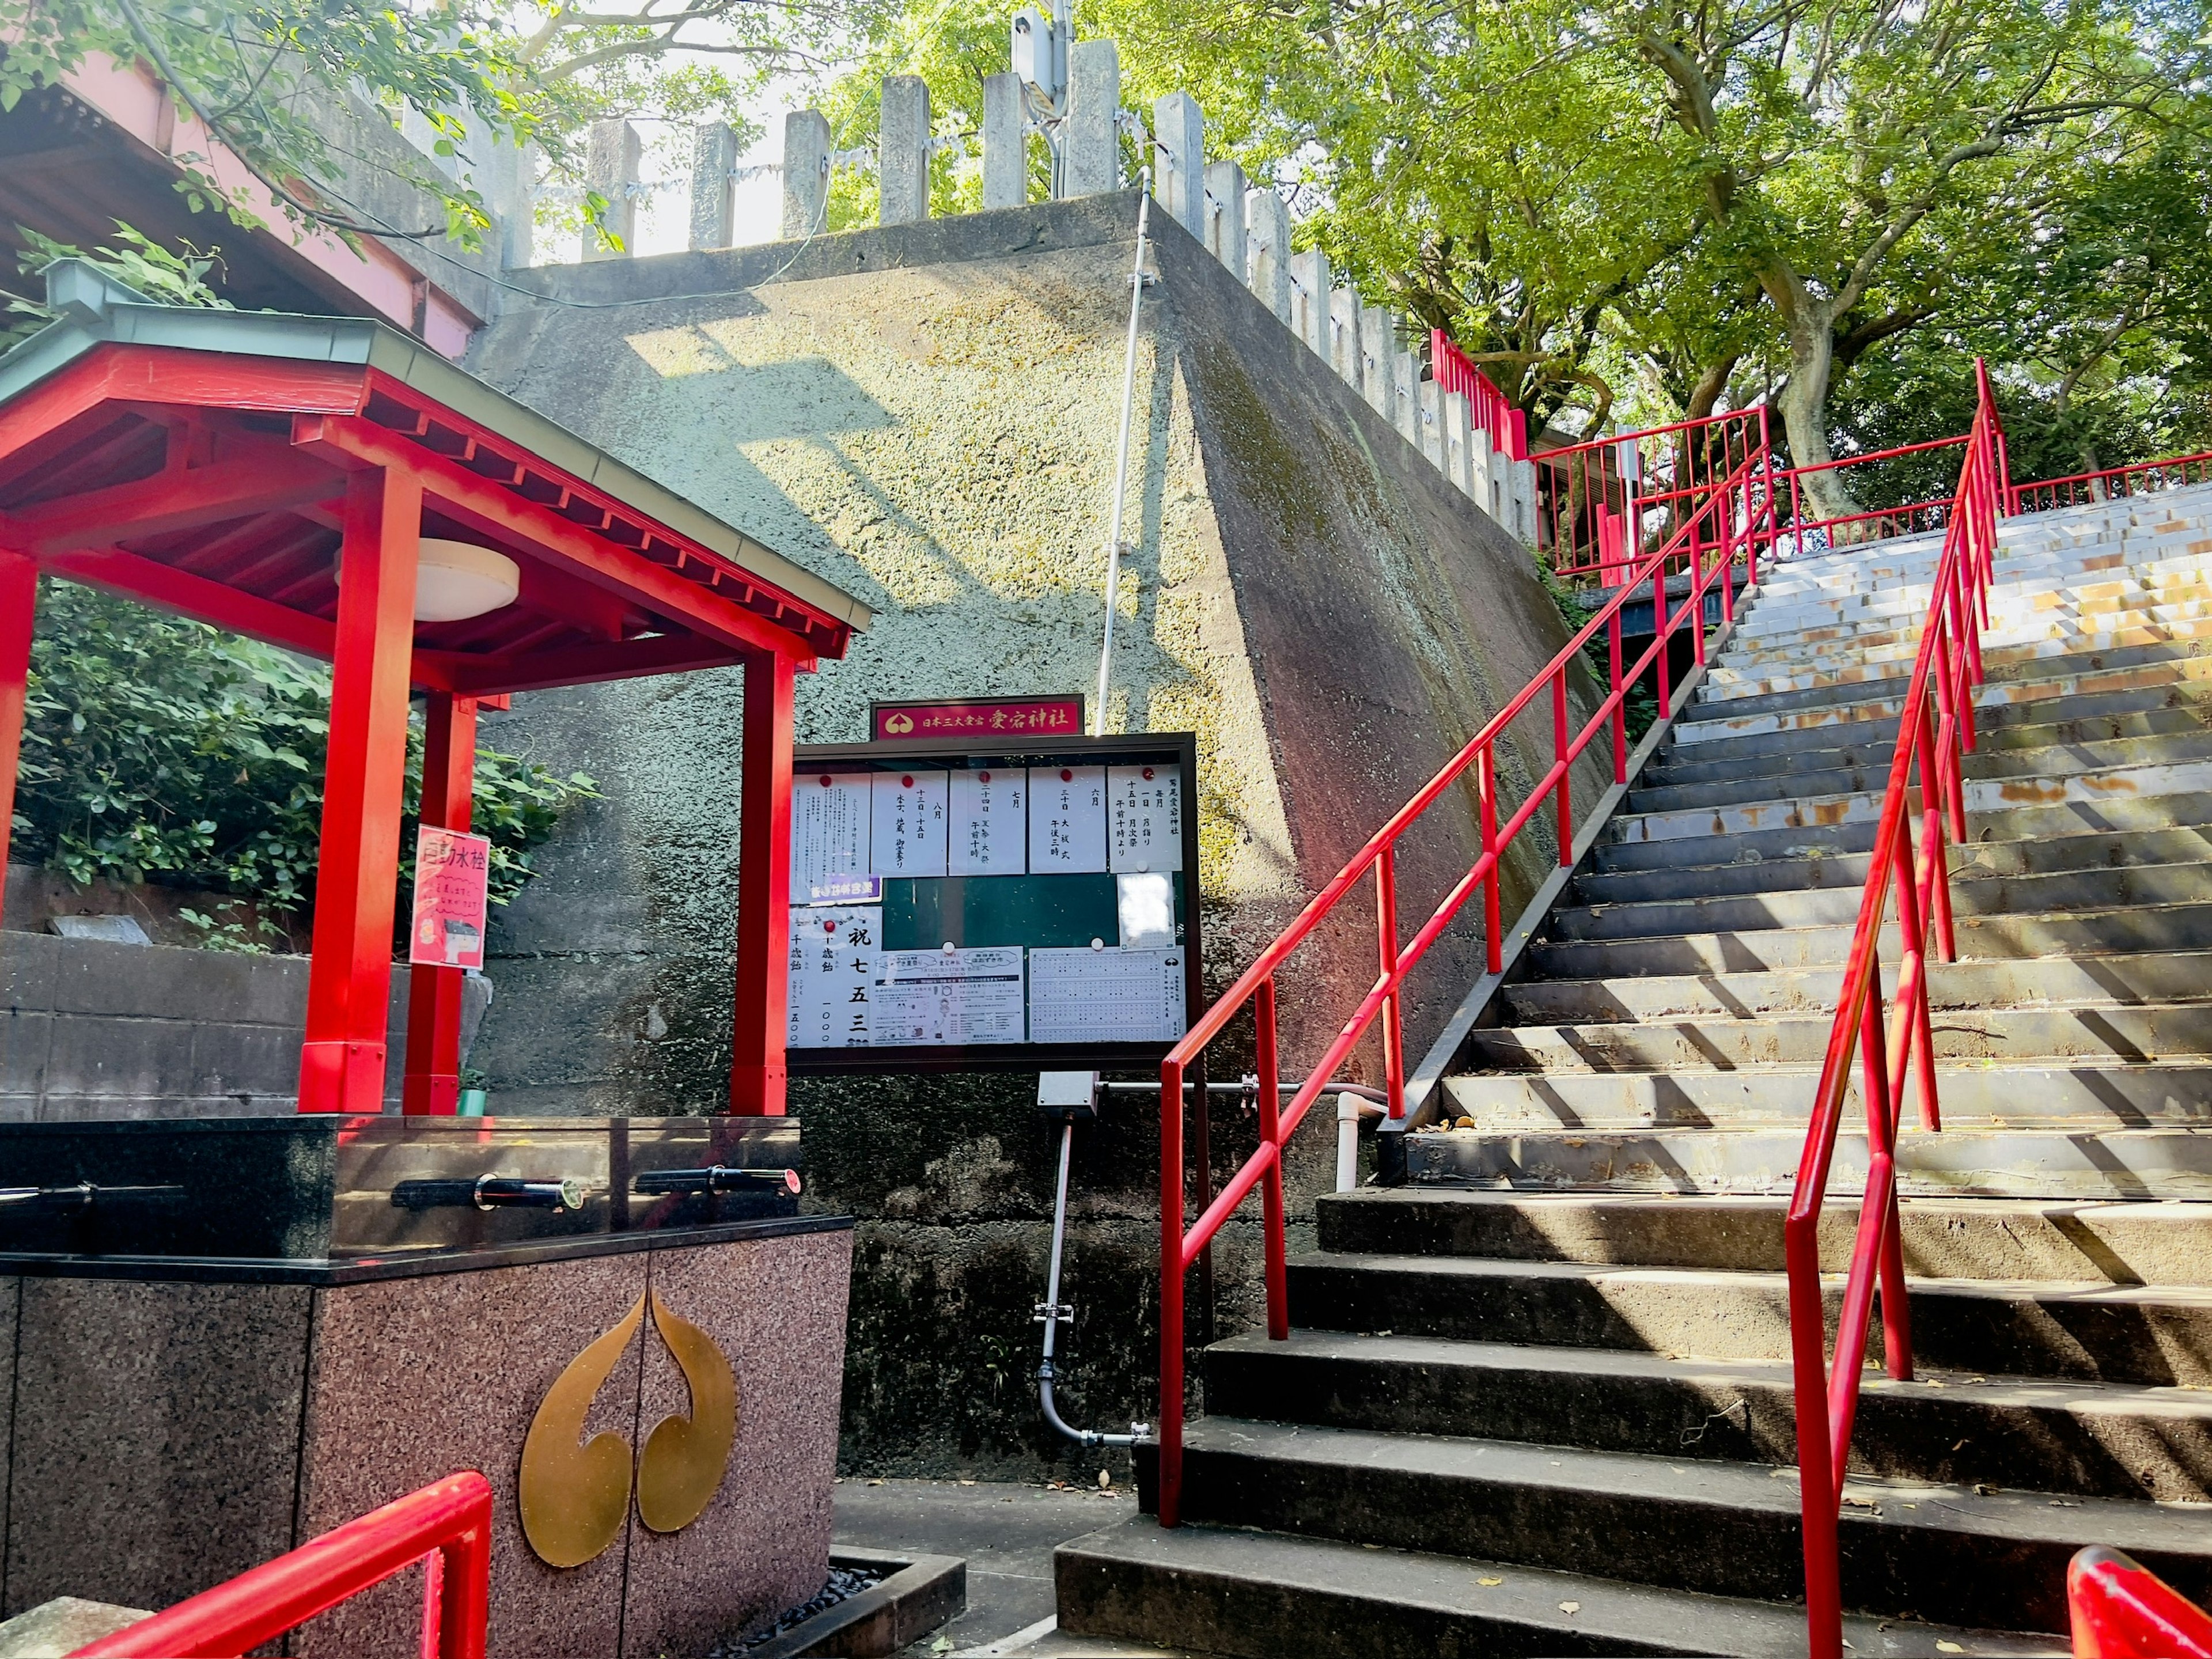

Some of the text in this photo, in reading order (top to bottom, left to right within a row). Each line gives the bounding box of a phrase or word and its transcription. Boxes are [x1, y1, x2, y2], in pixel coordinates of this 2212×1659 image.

[989, 708, 1069, 729] 愛宕神社
[981, 785, 990, 812] 二十四日
[1012, 791, 1021, 808] 七月
[1060, 789, 1069, 810] 三十日
[1091, 789, 1100, 806] 六月
[1141, 792, 1150, 808] 一日
[1156, 790, 1164, 808] 毎月
[933, 802, 942, 819] 八月
[1127, 781, 1138, 847] 十五日 月次祭
[1051, 820, 1059, 856] 午後三時
[1116, 800, 1125, 857] 午前十時より
[970, 821, 980, 858] 午前十時
[790, 934, 802, 971] 千歳飴
